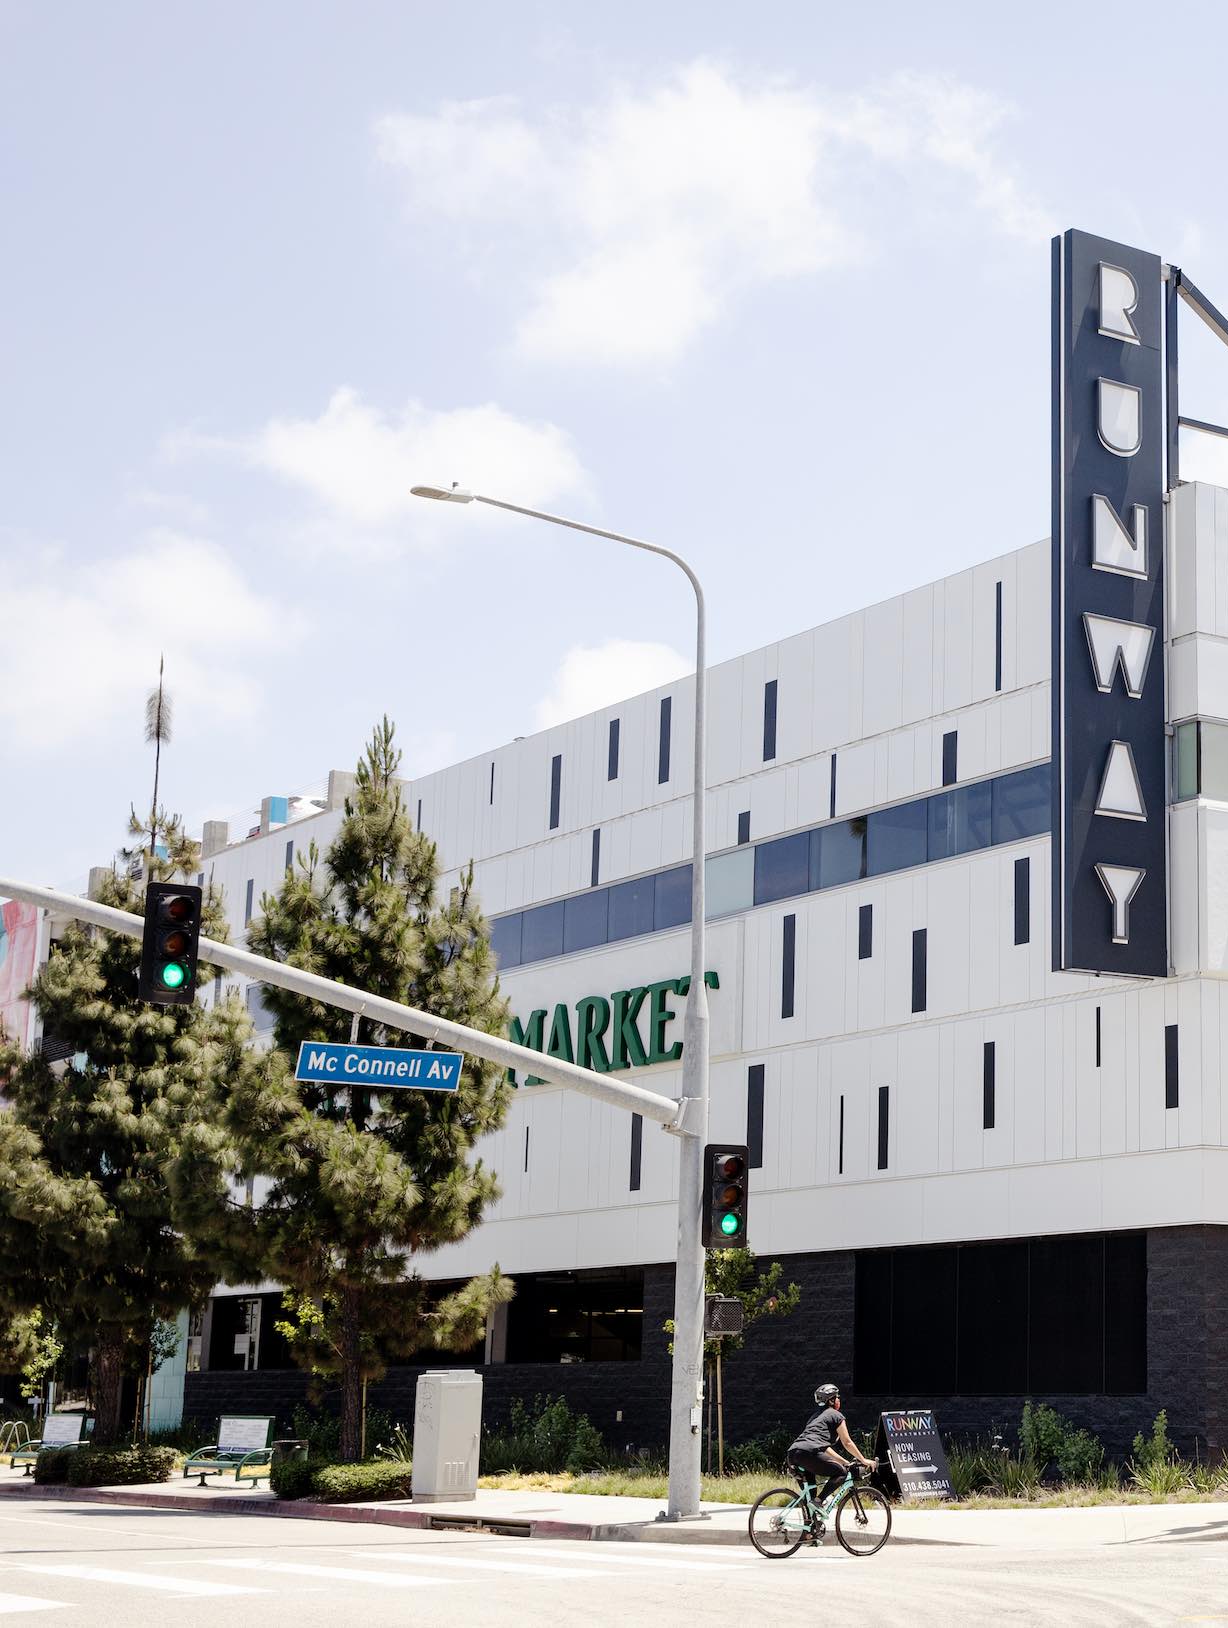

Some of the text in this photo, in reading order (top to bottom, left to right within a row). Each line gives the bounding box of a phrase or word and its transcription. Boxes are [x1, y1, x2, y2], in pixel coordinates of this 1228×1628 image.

[1082, 261, 1157, 944] RUNWAY
[307, 1051, 453, 1080] Mc Connell Av
[886, 1417, 931, 1431] RUNWAY
[894, 1443, 914, 1452] NOW
[897, 1452, 932, 1463] LEASING
[902, 1480, 950, 1491] 310.438.5041
